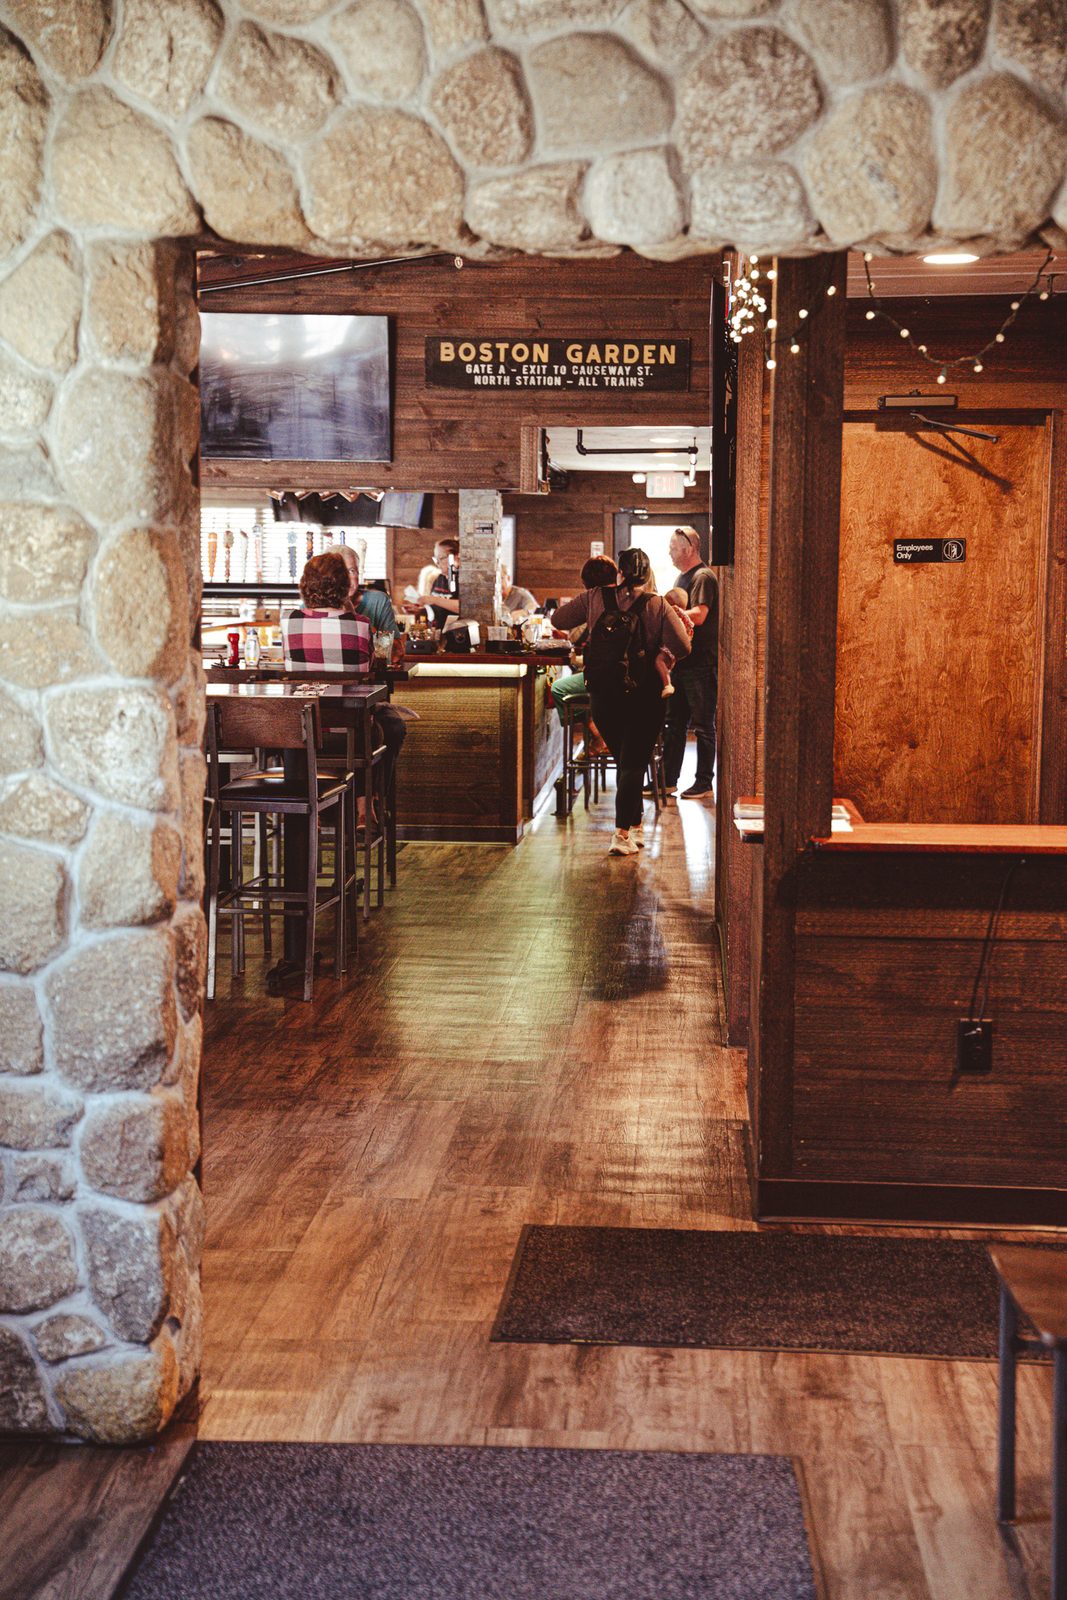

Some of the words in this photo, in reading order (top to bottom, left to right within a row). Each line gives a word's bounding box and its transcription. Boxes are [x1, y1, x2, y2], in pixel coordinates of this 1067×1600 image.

[440, 342, 549, 363] BOSTON
[566, 344, 676, 365] GARDEN
[465, 364, 493, 374] GATE
[498, 365, 506, 375] A
[522, 365, 547, 375] EXIT
[553, 365, 567, 375] TO
[572, 365, 631, 376] CAUSEWAY
[637, 366, 653, 376] ST.
[474, 375, 510, 386] NORTH
[515, 376, 561, 386] STATION
[578, 377, 598, 387] ALL
[604, 377, 644, 387] TRAINS
[896, 544, 933, 552] Employees
[896, 552, 912, 560] Only
